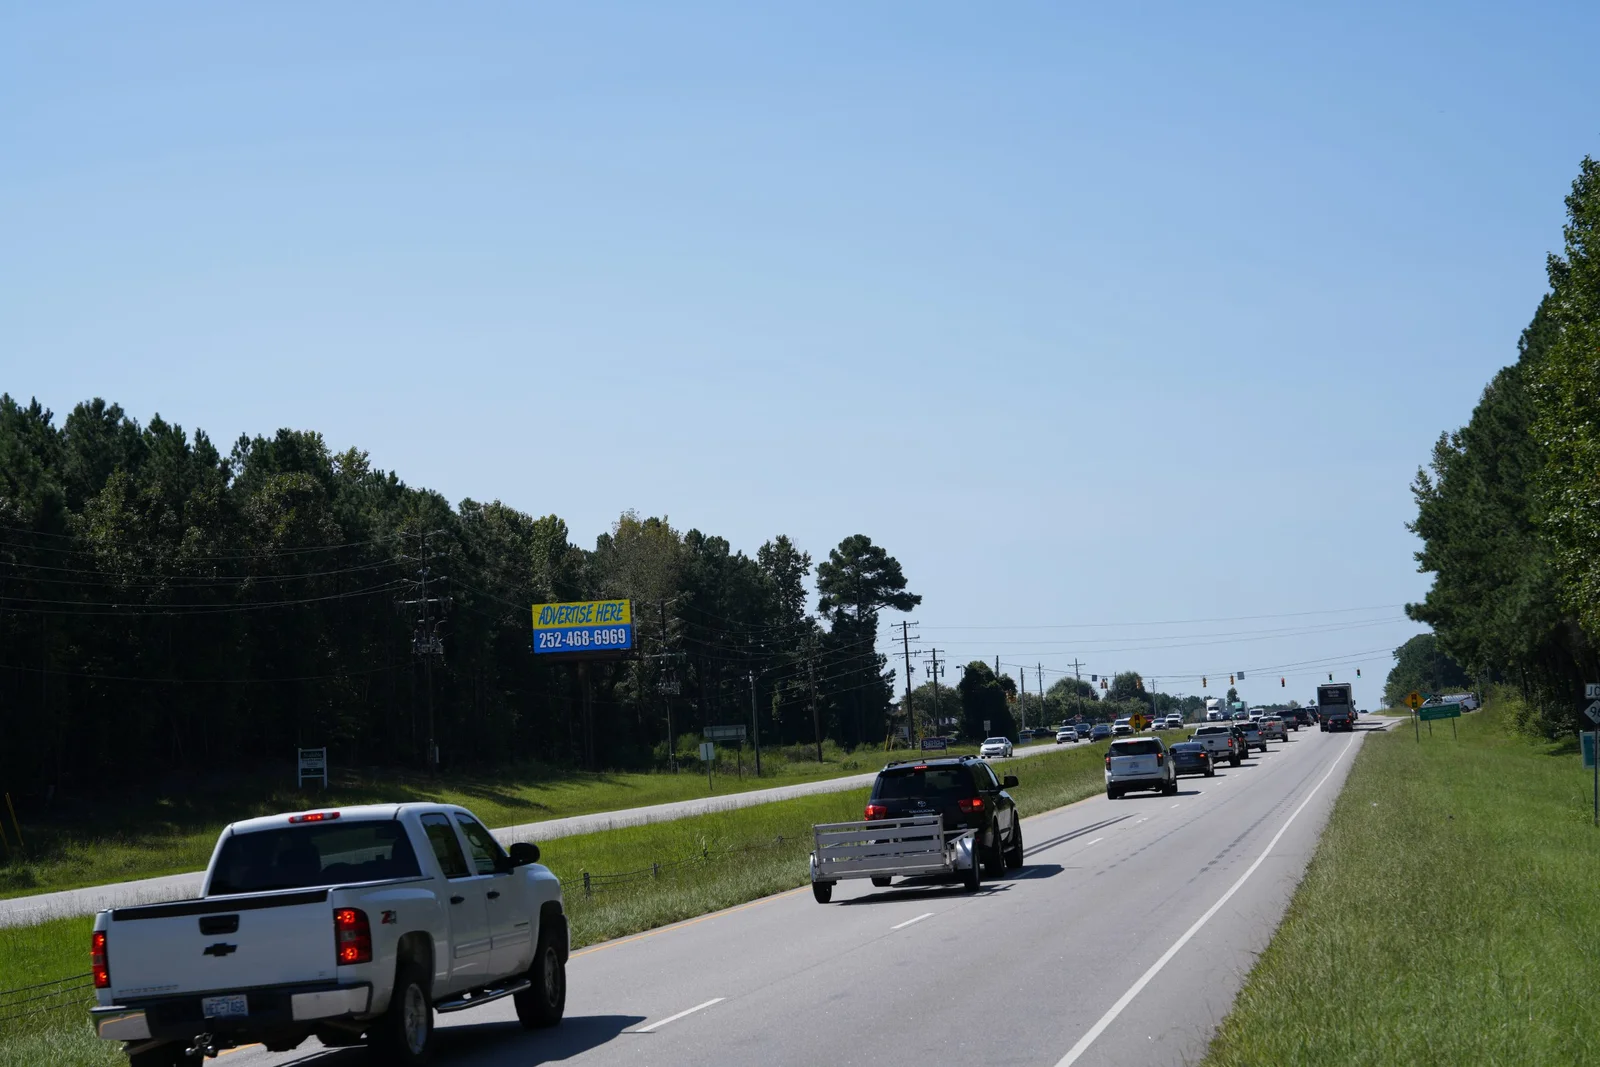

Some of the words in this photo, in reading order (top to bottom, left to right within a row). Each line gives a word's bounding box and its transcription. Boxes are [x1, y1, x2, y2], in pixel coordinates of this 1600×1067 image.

[538, 604, 593, 625] ADVERTISE
[596, 602, 624, 622] HERE
[539, 628, 626, 648] 252-468-6969
